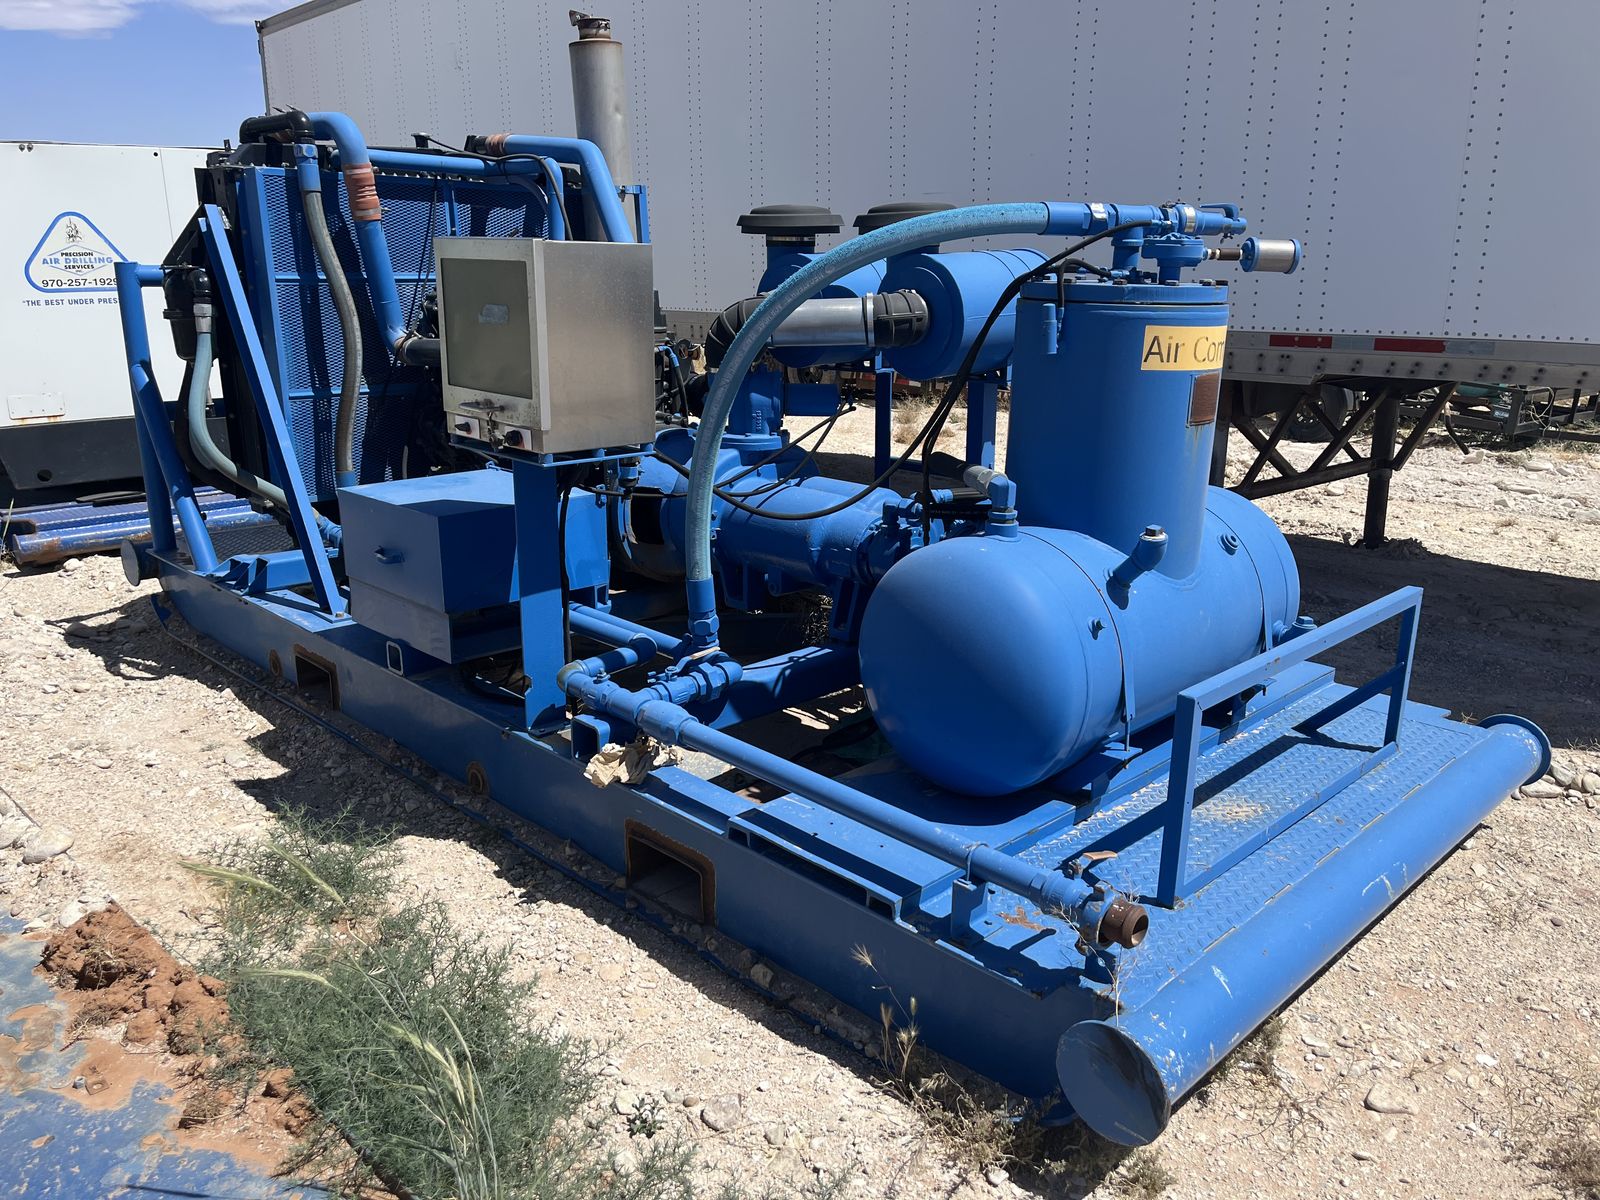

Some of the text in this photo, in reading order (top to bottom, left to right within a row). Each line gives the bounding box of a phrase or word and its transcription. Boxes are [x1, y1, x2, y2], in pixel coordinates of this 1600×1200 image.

[42, 256, 114, 265] AIR DRILLING
[1143, 335, 1185, 363] Air
